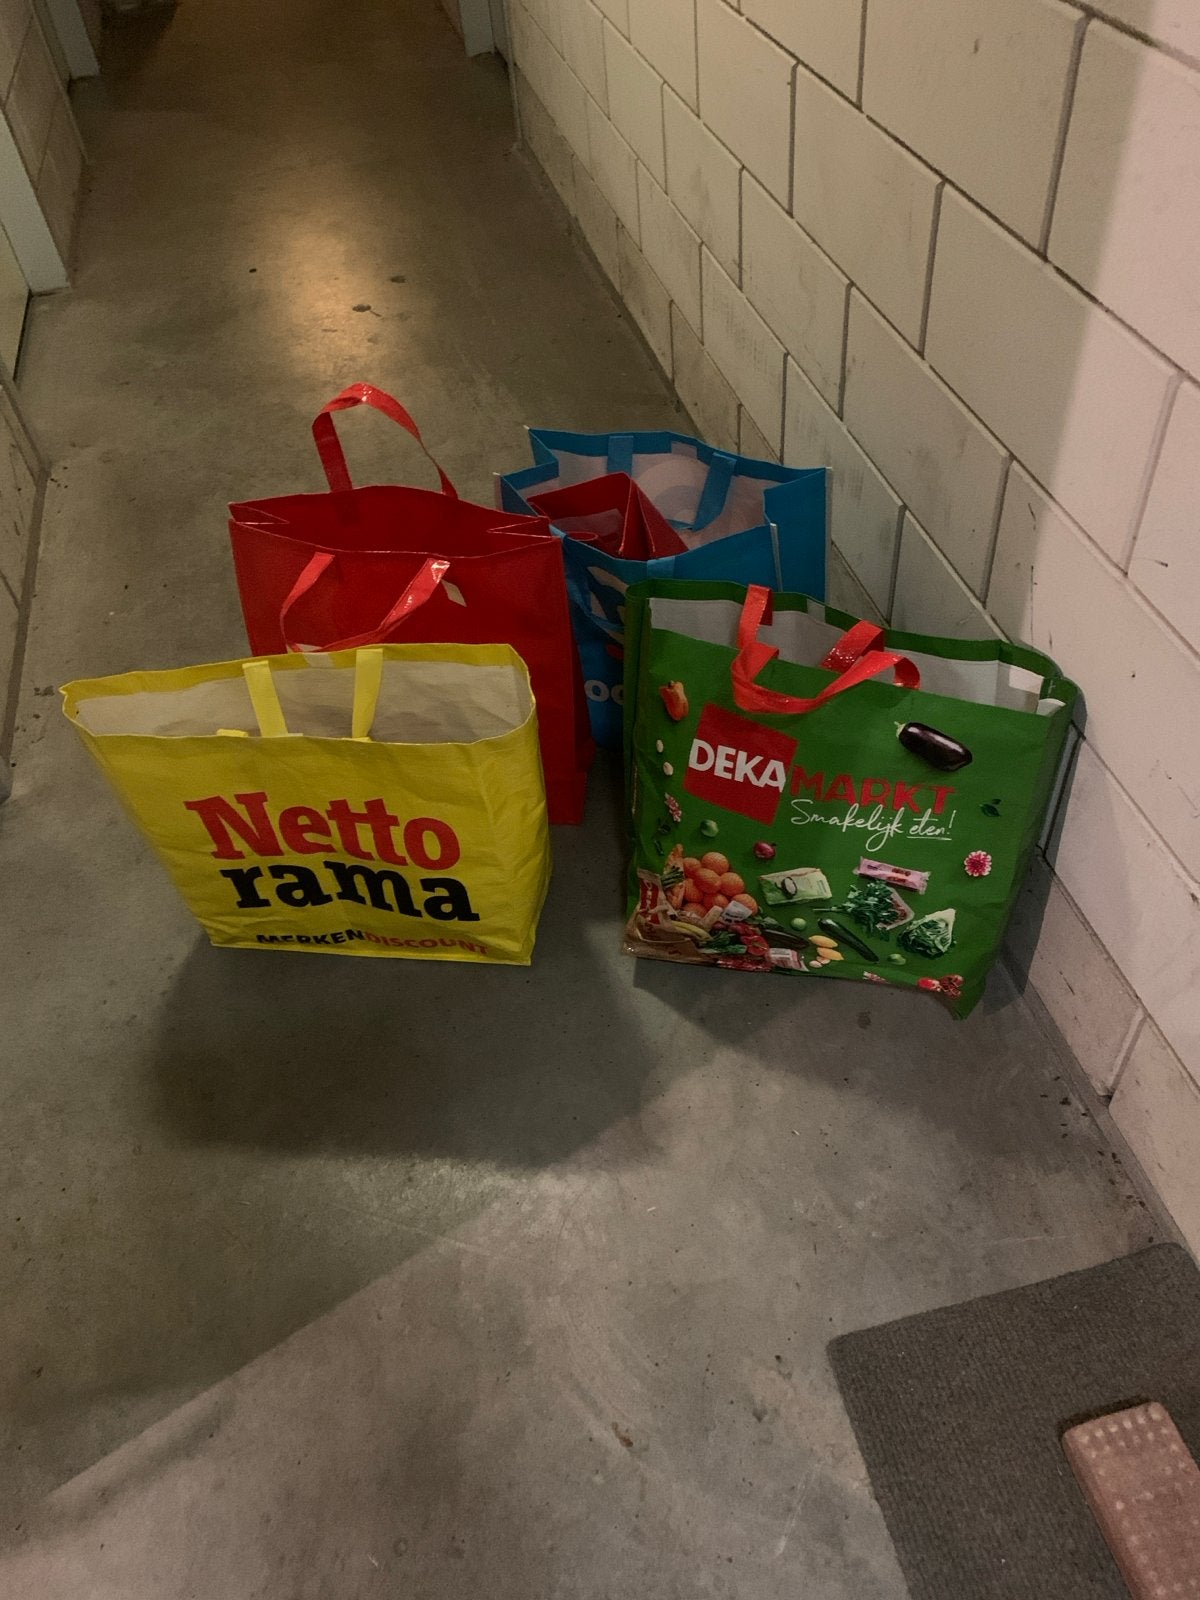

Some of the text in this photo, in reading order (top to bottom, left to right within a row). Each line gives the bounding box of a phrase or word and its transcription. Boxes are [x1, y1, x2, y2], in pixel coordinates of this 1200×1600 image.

[183, 791, 461, 870] Netto
[790, 798, 957, 852] Smakelijk eten!
[219, 860, 481, 922] rama
